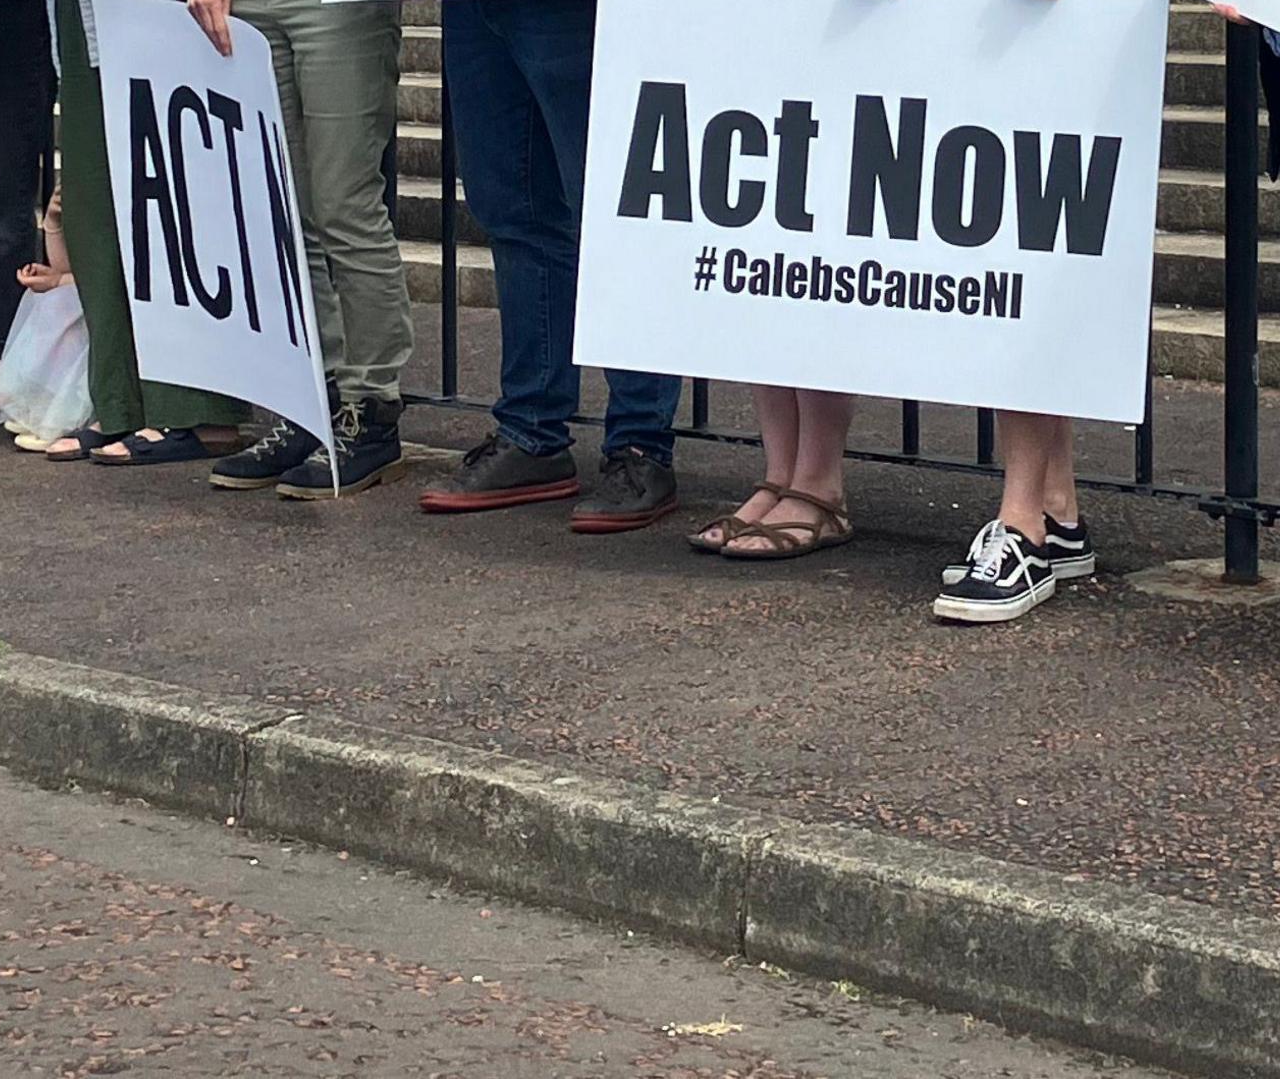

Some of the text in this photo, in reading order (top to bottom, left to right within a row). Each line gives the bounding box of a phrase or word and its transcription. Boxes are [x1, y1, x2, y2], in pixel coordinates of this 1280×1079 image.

[130, 77, 261, 333] ACT
[616, 81, 1123, 257] Act Now
[695, 247, 1023, 319] #CalebsCauseNI
